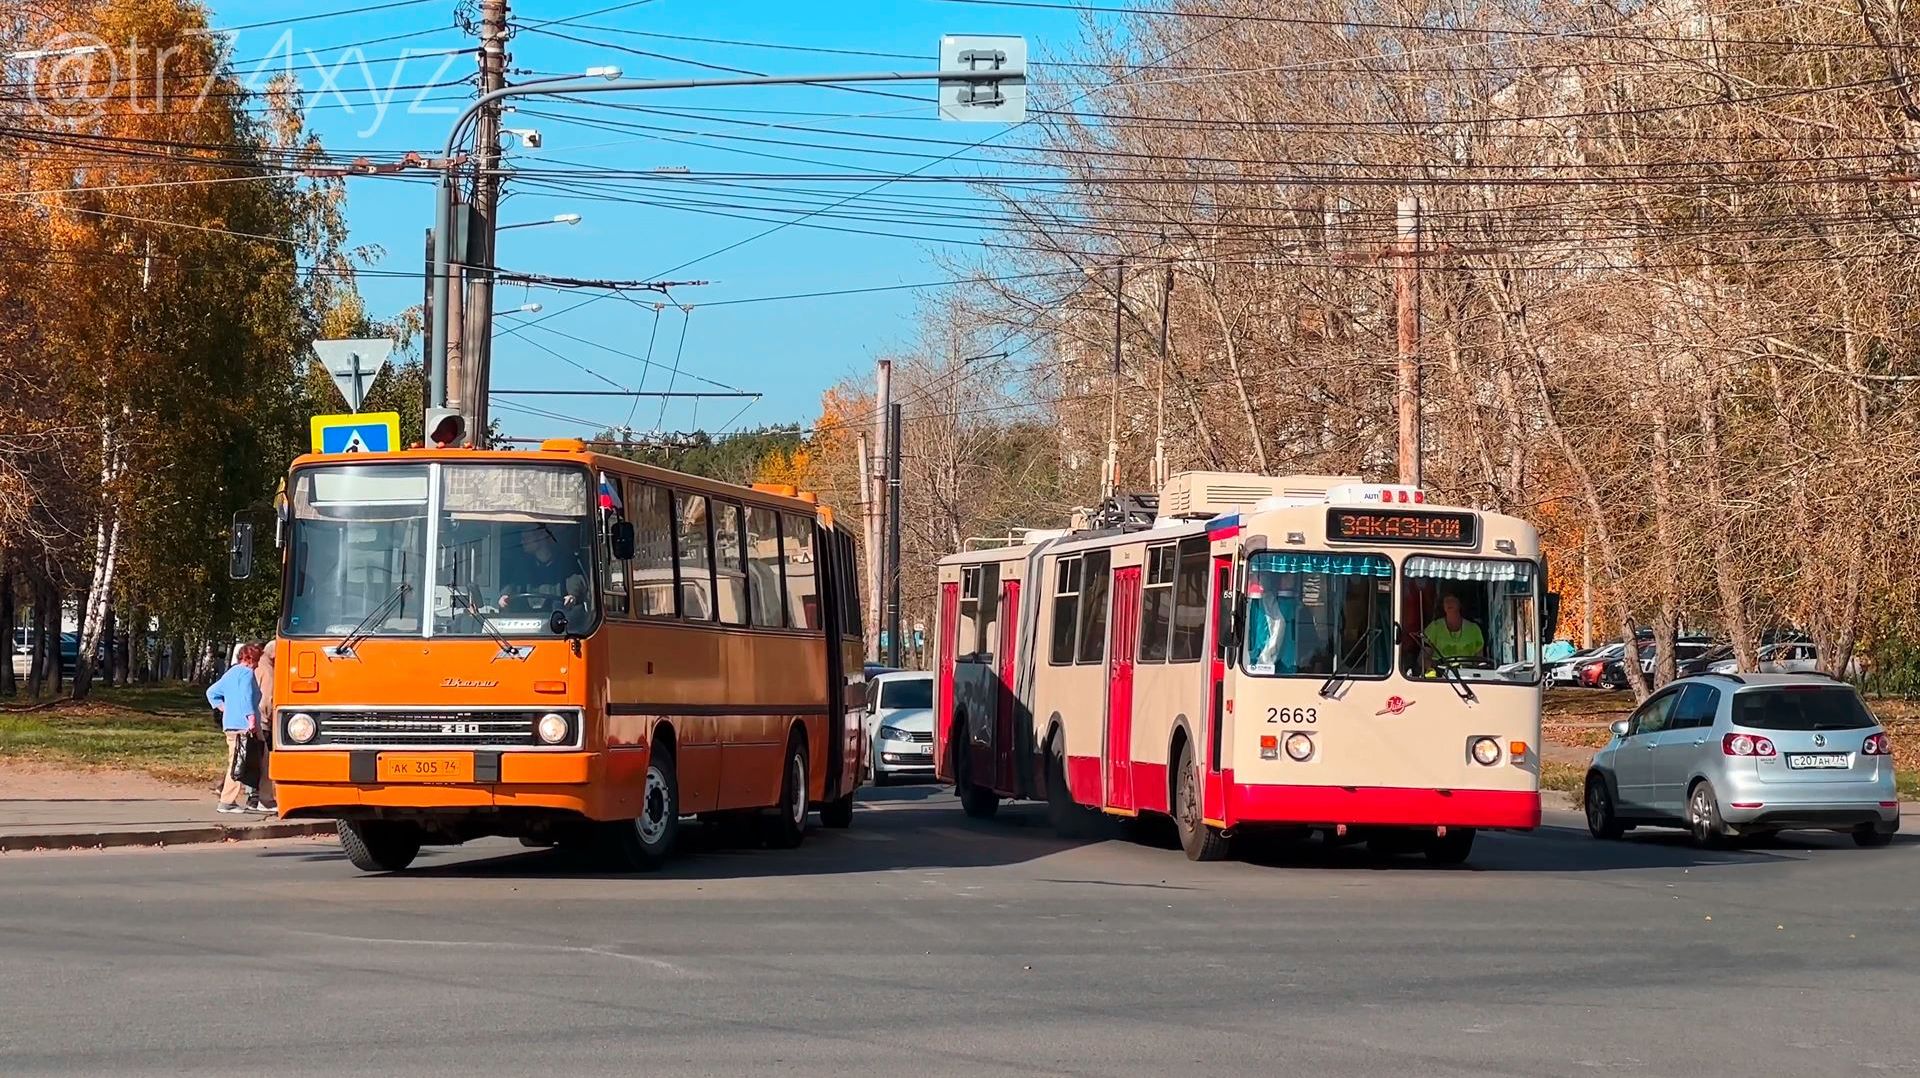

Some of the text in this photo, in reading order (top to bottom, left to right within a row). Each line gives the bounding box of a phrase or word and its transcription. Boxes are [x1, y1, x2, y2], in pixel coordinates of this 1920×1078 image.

[1267, 707, 1317, 723] 2663
[416, 761, 438, 773] 305
[445, 761, 456, 770] 74
